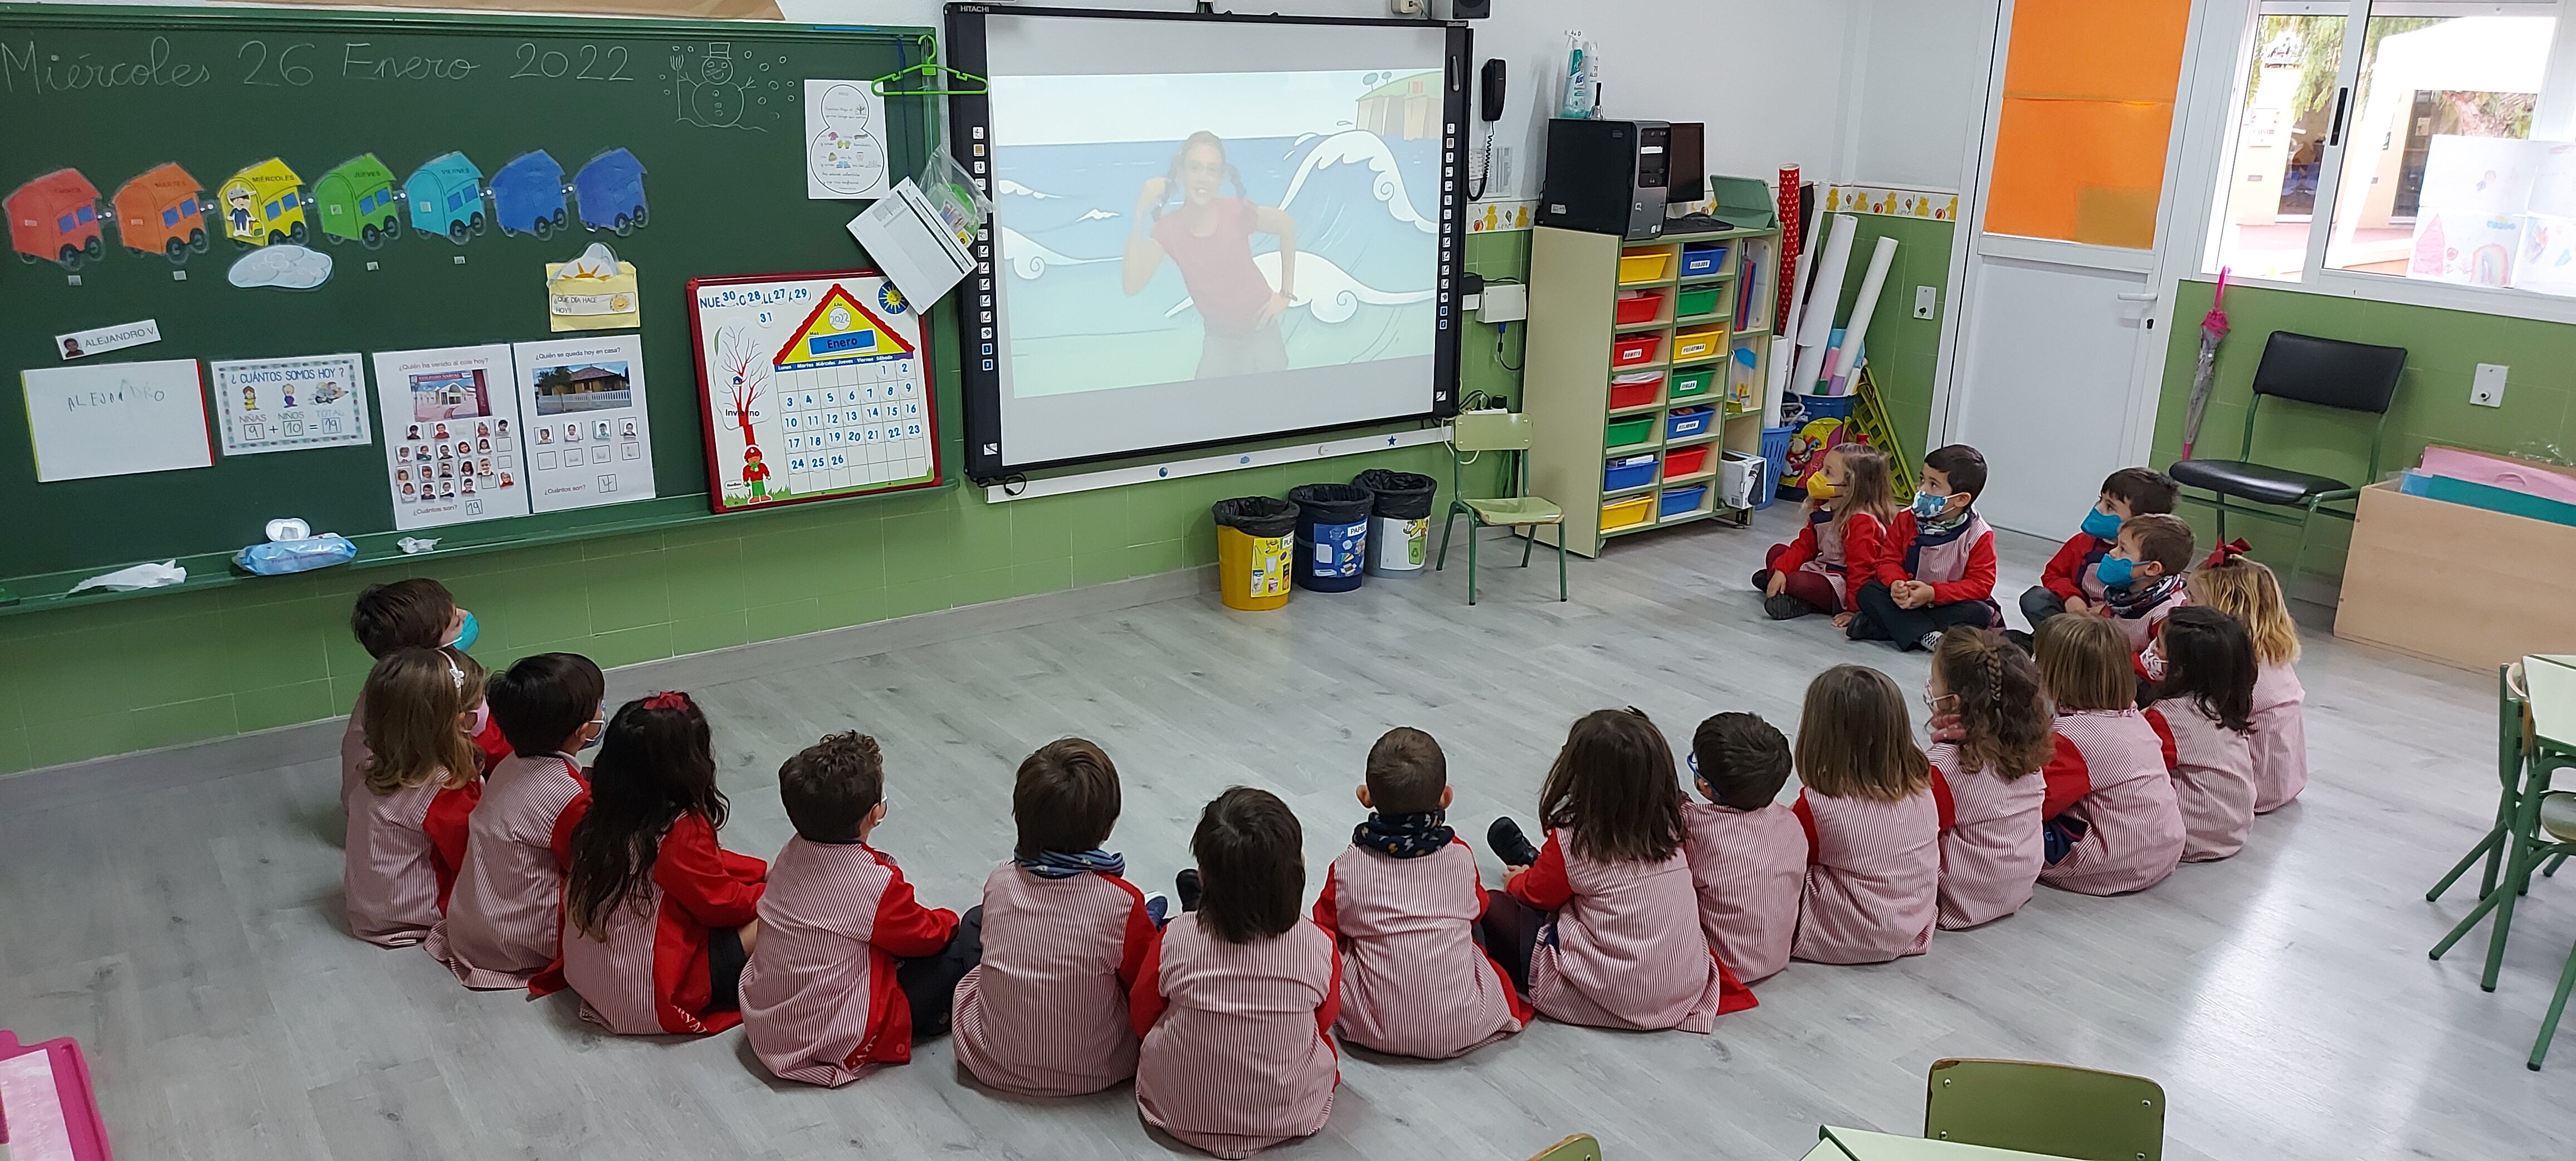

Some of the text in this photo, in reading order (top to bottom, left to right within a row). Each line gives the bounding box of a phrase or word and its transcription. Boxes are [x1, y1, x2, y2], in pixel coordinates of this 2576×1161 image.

[2, 37, 633, 94] Miércoles 26 Enero 2022
[723, 290, 736, 301] 30
[747, 290, 761, 302] 28
[773, 288, 785, 299] 27
[794, 288, 807, 299] 29
[760, 312, 772, 323] 31
[830, 313, 851, 325] 2022
[85, 329, 145, 348] ALEJANDRO
[827, 337, 858, 349] Enero
[882, 363, 908, 374] 1 2
[240, 370, 282, 383] CUÁNTOS
[285, 369, 315, 381] SOMOS
[318, 368, 335, 379] HOY
[787, 383, 911, 407] 3 4 5 6 7 8 9
[240, 409, 344, 423] NIÑAS NIÑOS TOTAL
[785, 403, 916, 427] 10 11 12 13 14 15 16
[249, 426, 258, 437] 9
[286, 422, 301, 434] 10
[325, 418, 338, 428] 19
[788, 425, 920, 448] 17 18 19 20 21 22 23
[792, 455, 844, 469] 24 25 26
[544, 486, 572, 495] ¿Cuántos
[413, 507, 442, 516] ¿Cuántos
[467, 502, 480, 514] 19
